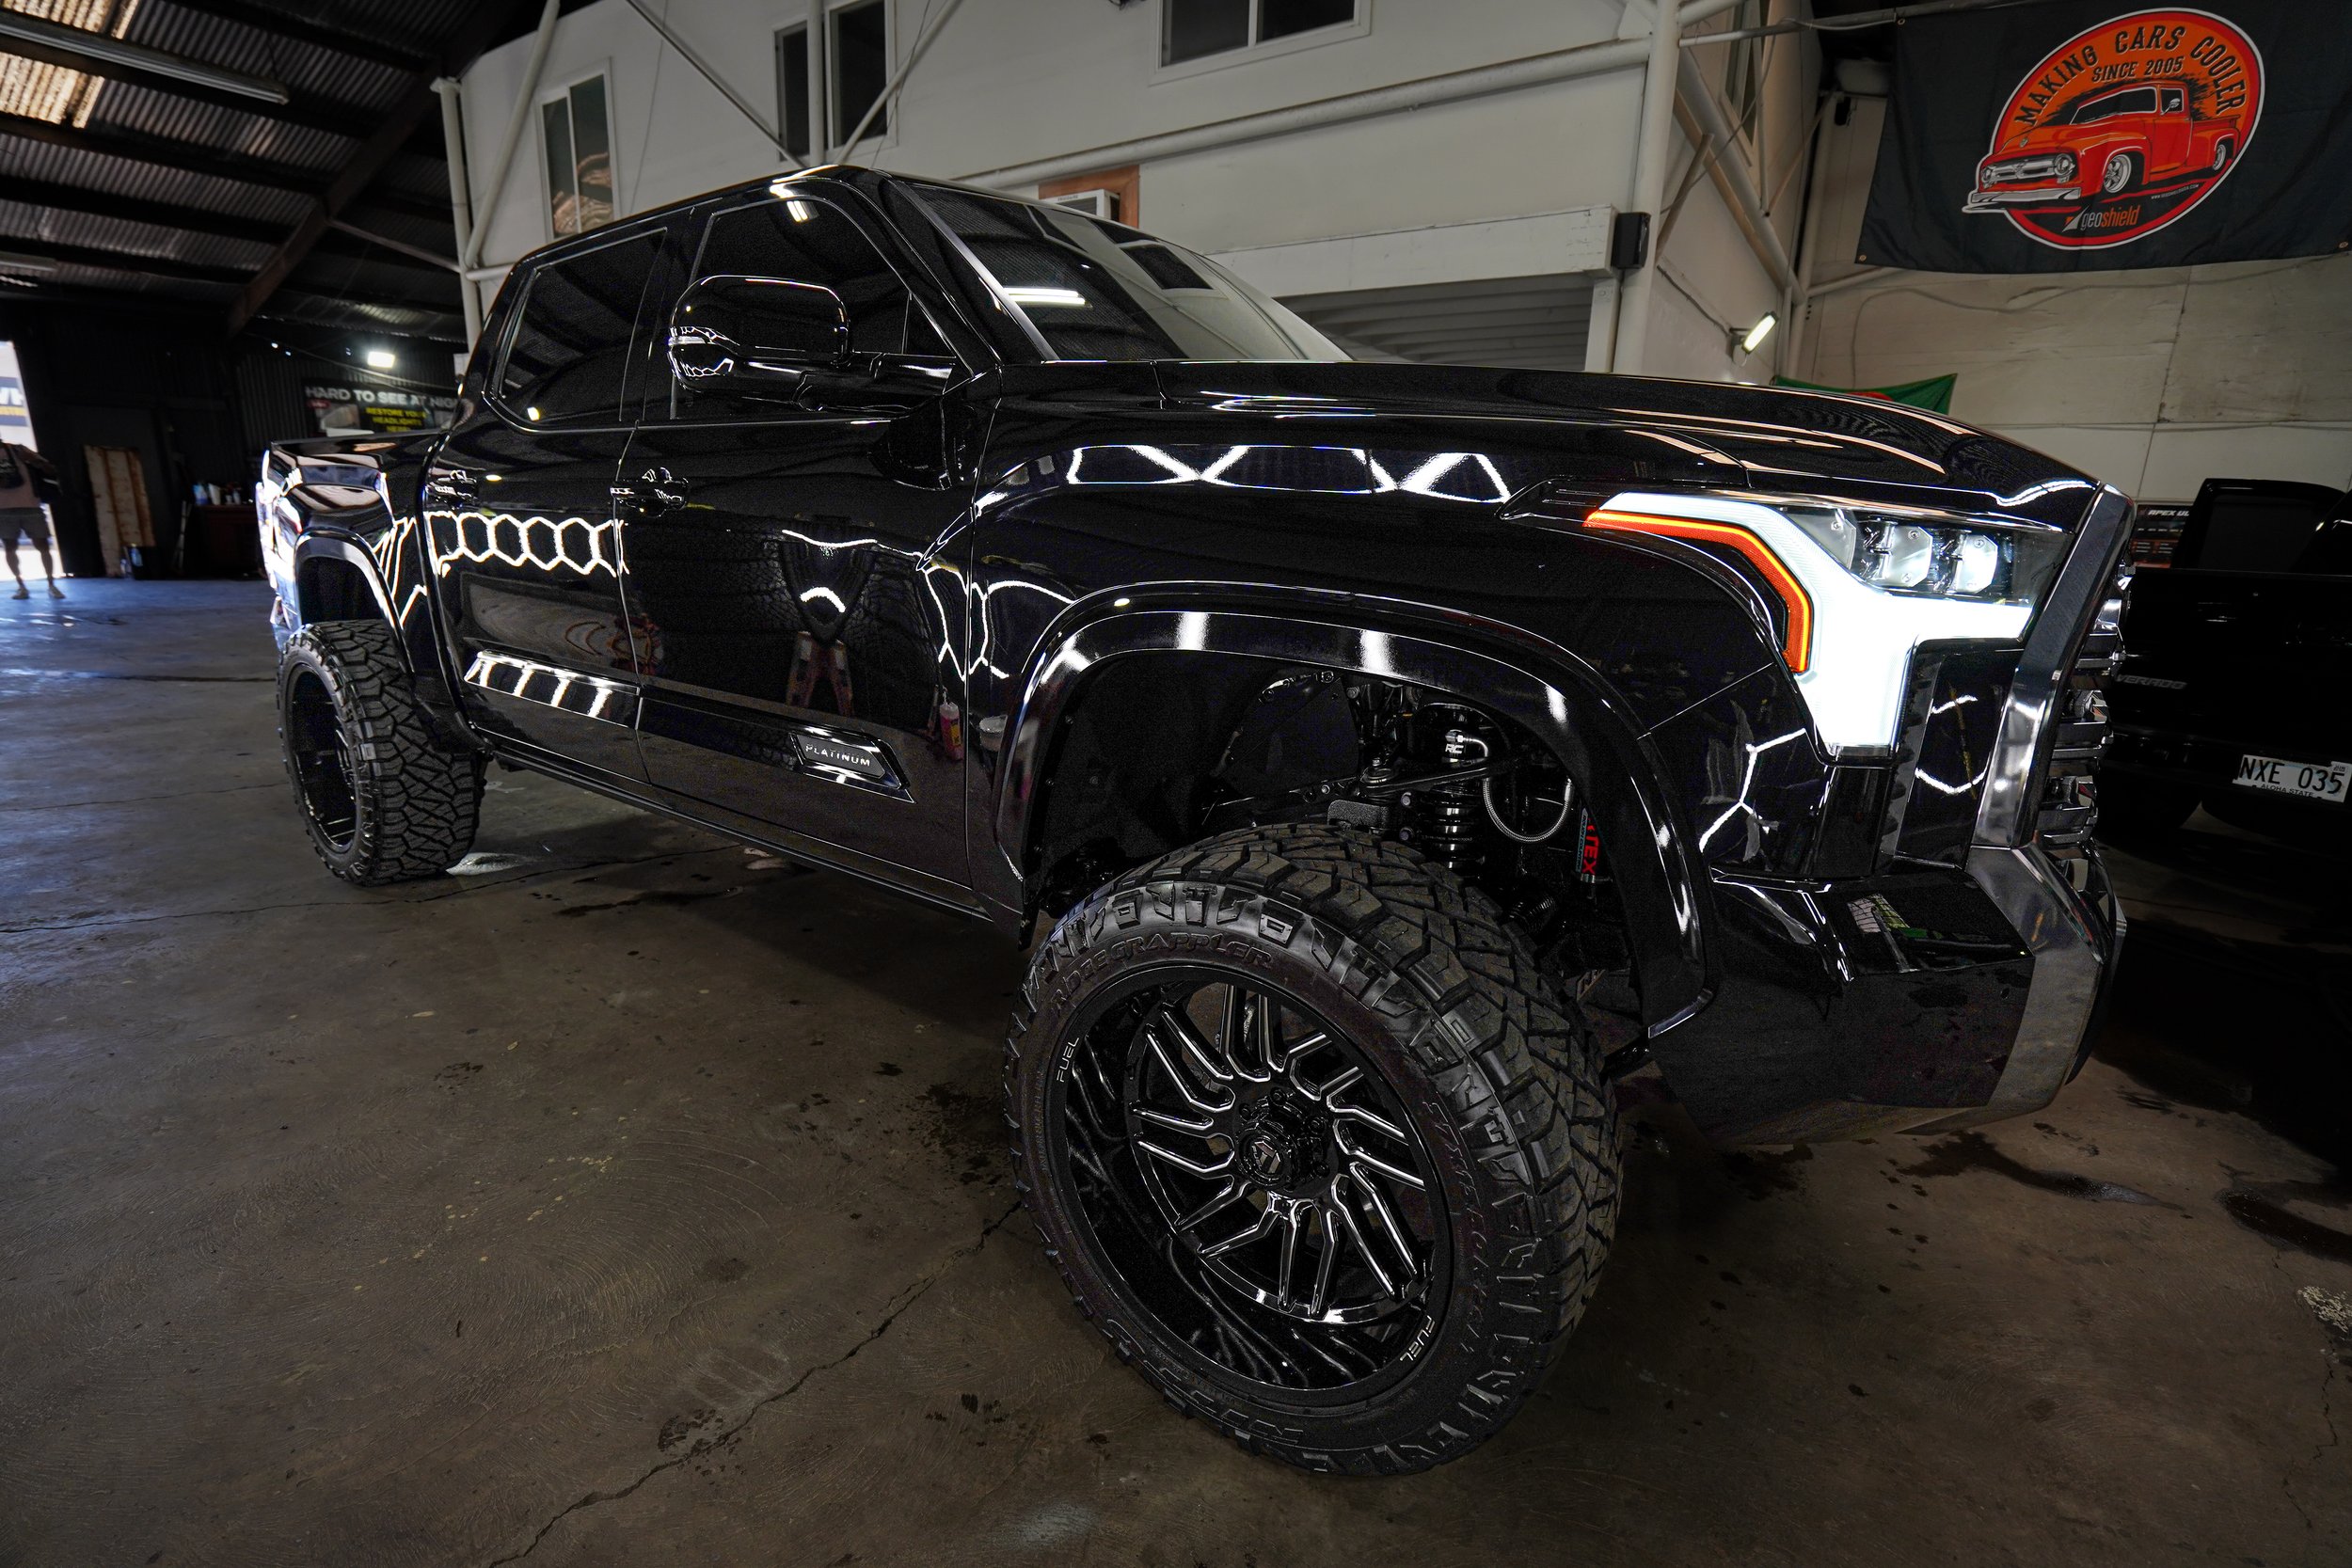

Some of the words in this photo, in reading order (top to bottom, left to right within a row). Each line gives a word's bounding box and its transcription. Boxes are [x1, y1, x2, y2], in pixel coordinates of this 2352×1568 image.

[2015, 45, 2099, 126] MAKING
[2115, 25, 2186, 55] CARS
[2189, 36, 2247, 117] COOLER
[2091, 61, 2138, 83] SINCE
[2144, 55, 2185, 77] 2005
[2080, 205, 2139, 231] geoshield
[305, 387, 351, 401] HARD
[353, 389, 375, 403] TO
[377, 391, 407, 405] SEE
[409, 395, 427, 405] AT
[429, 397, 458, 409] NIG
[2115, 673, 2187, 689] VERADO
[804, 743, 871, 767] PLATINUM
[1444, 743, 1465, 754] RC
[2239, 757, 2285, 784] NXE
[2297, 767, 2345, 795] 035
[2260, 784, 2287, 793] ALOHA
[2289, 788, 2315, 798] STATE
[1109, 931, 1273, 970] GRAPPLER
[1057, 1037, 1080, 1083] FUEL
[1399, 1314, 1436, 1362] FUEL
